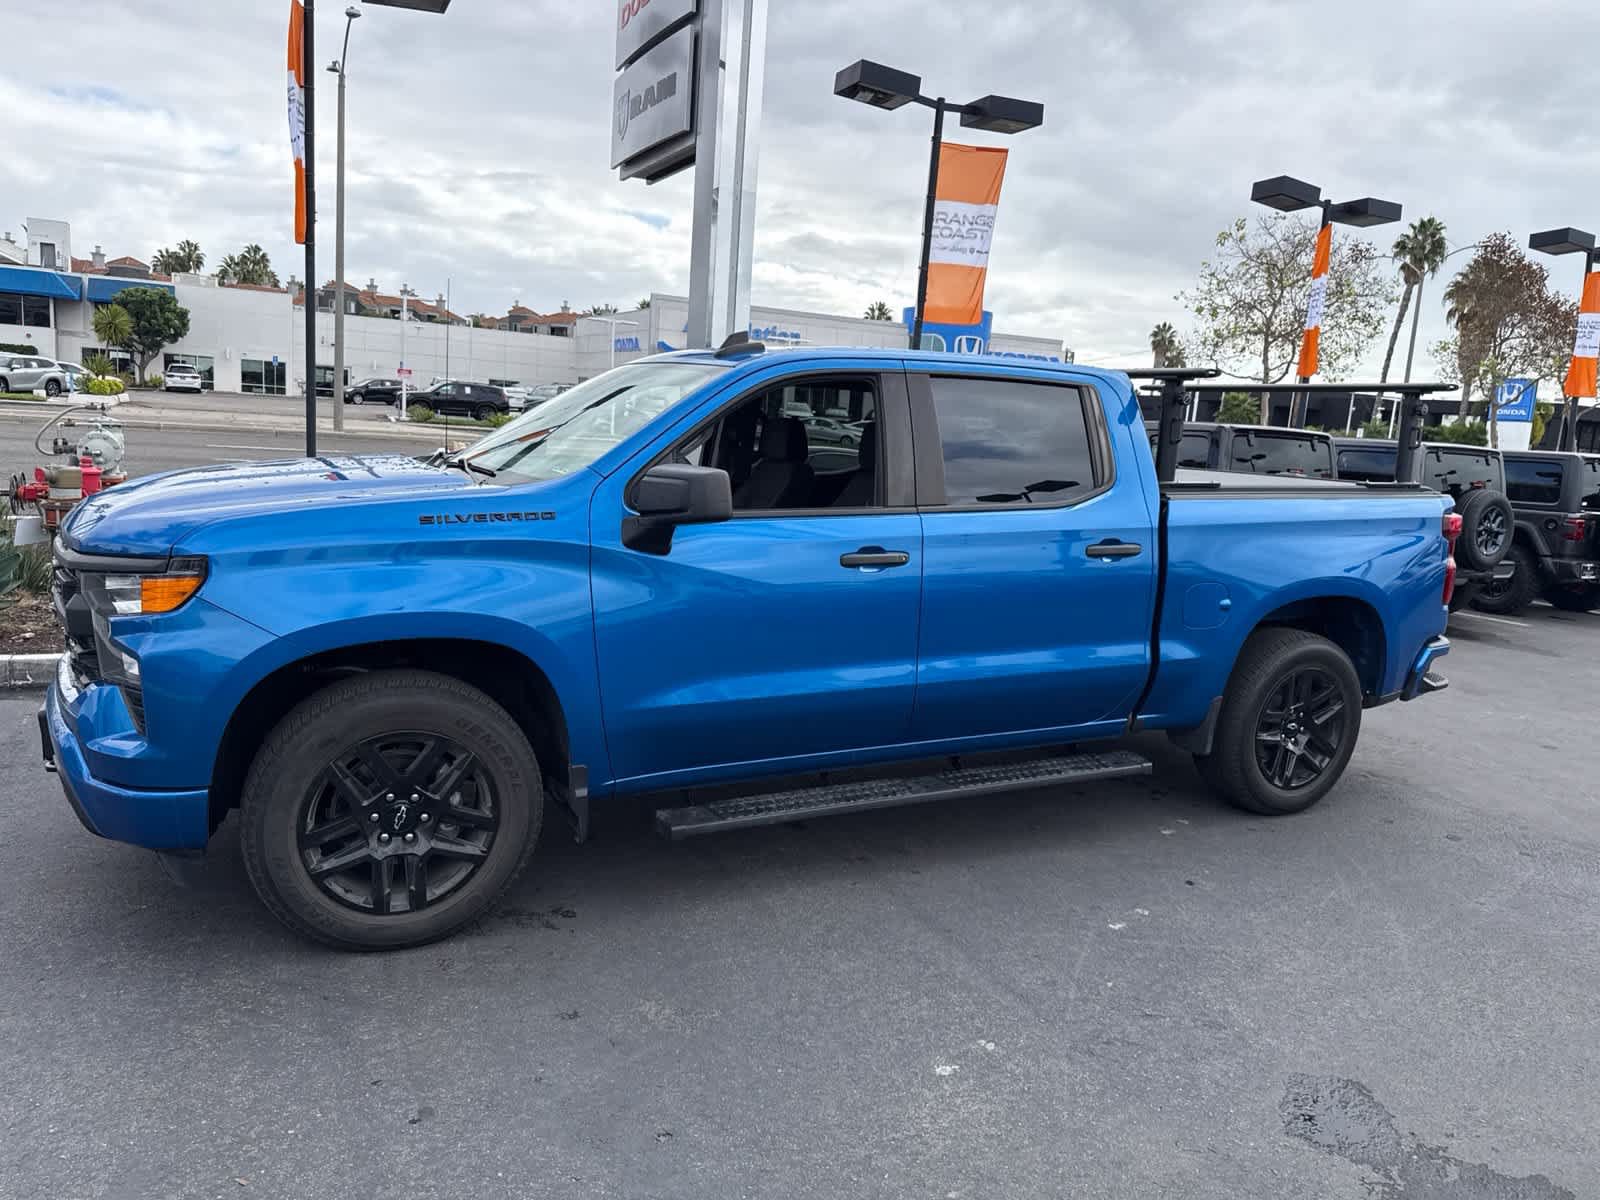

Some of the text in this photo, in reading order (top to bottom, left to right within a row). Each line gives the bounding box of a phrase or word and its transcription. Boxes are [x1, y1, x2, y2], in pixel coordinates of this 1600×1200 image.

[630, 71, 677, 120] RAM
[934, 211, 995, 228] RANGE
[1496, 408, 1527, 416] ONDA
[418, 511, 556, 525] SILVERADO
